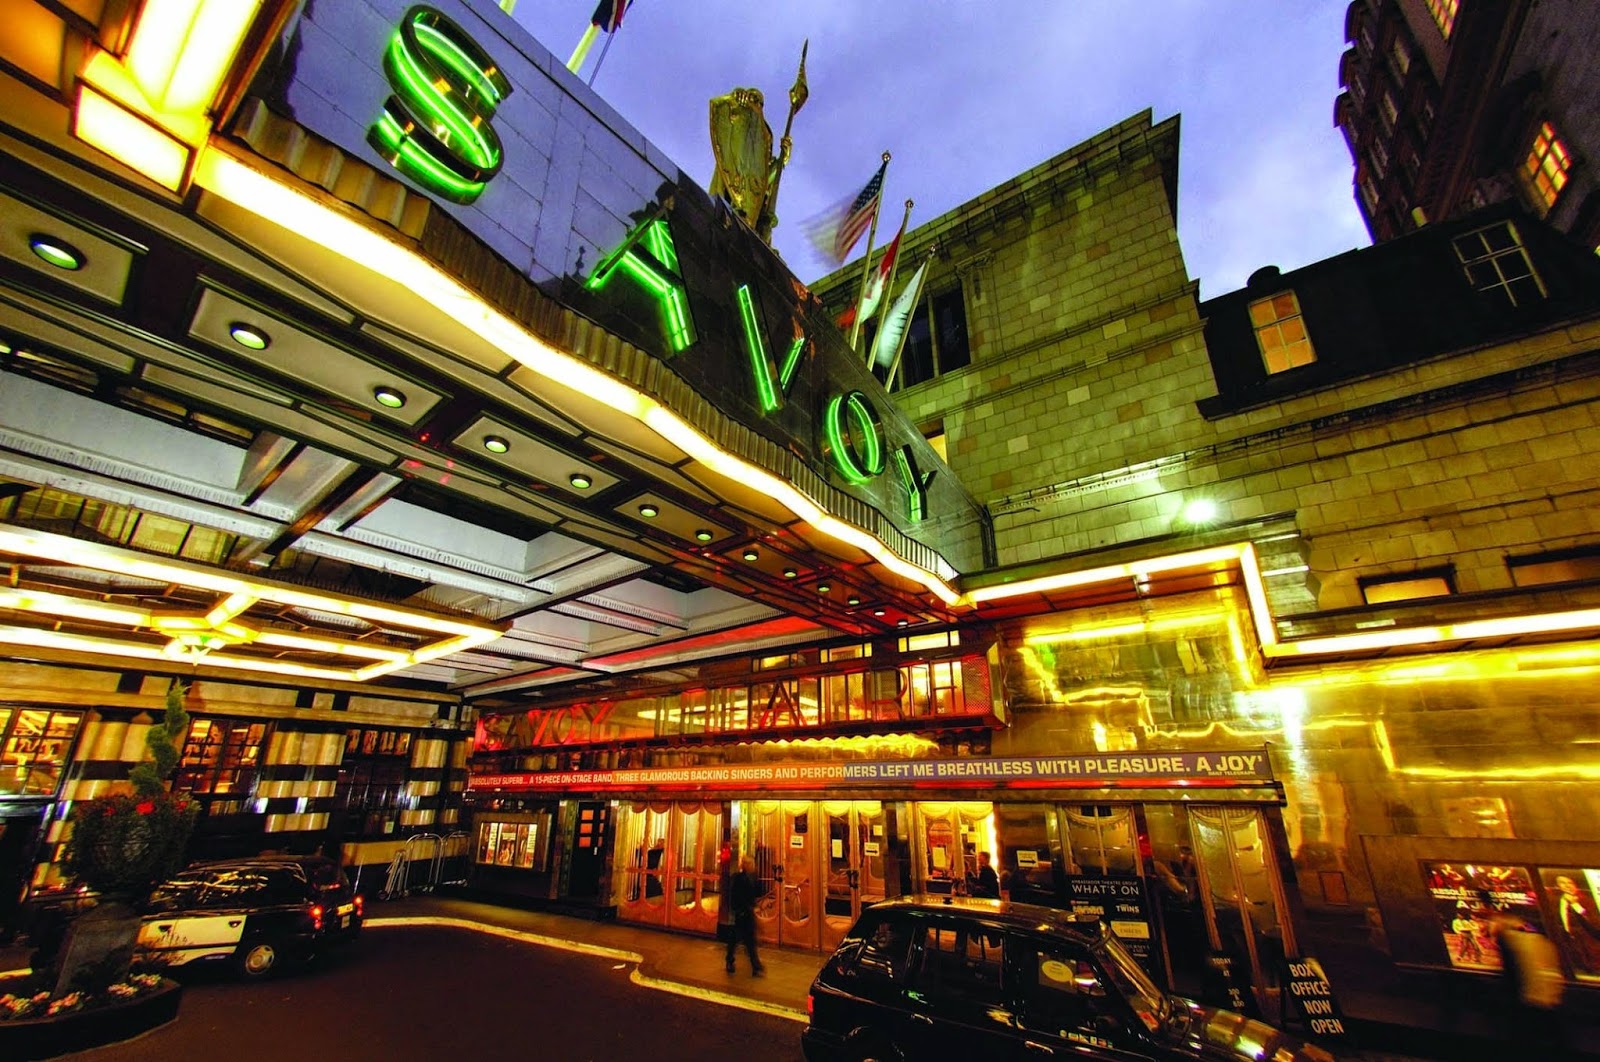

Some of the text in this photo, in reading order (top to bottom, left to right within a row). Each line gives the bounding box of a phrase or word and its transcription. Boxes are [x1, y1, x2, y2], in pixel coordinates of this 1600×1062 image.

[366, 2, 938, 523] SAVOY
[483, 702, 616, 751] SAVOY
[529, 776, 534, 784] A
[535, 775, 561, 784] 15-PIECE
[561, 774, 592, 784] ON-STAGE
[616, 772, 640, 782] THREE
[640, 770, 689, 782] GLAMOROUS
[691, 769, 729, 780] BACKING
[731, 768, 773, 779] SINGERS
[775, 767, 798, 778] AND
[800, 765, 877, 778] PERFORMERS
[880, 764, 909, 777] LEFT
[913, 764, 934, 777] ME
[938, 760, 1033, 776] BREATHLESS
[1035, 759, 1080, 774] WITH
[1085, 756, 1191, 774] PLEASURE.
[1196, 756, 1212, 772] A
[1071, 884, 1140, 895] WHAT'S ON
[1115, 904, 1140, 914] TWINS
[1212, 957, 1232, 965] TODAY
[1289, 964, 1316, 978] BOX
[1291, 981, 1331, 996] OFFICE
[1303, 1000, 1333, 1015] NOW
[1311, 1018, 1344, 1034] OPEN
